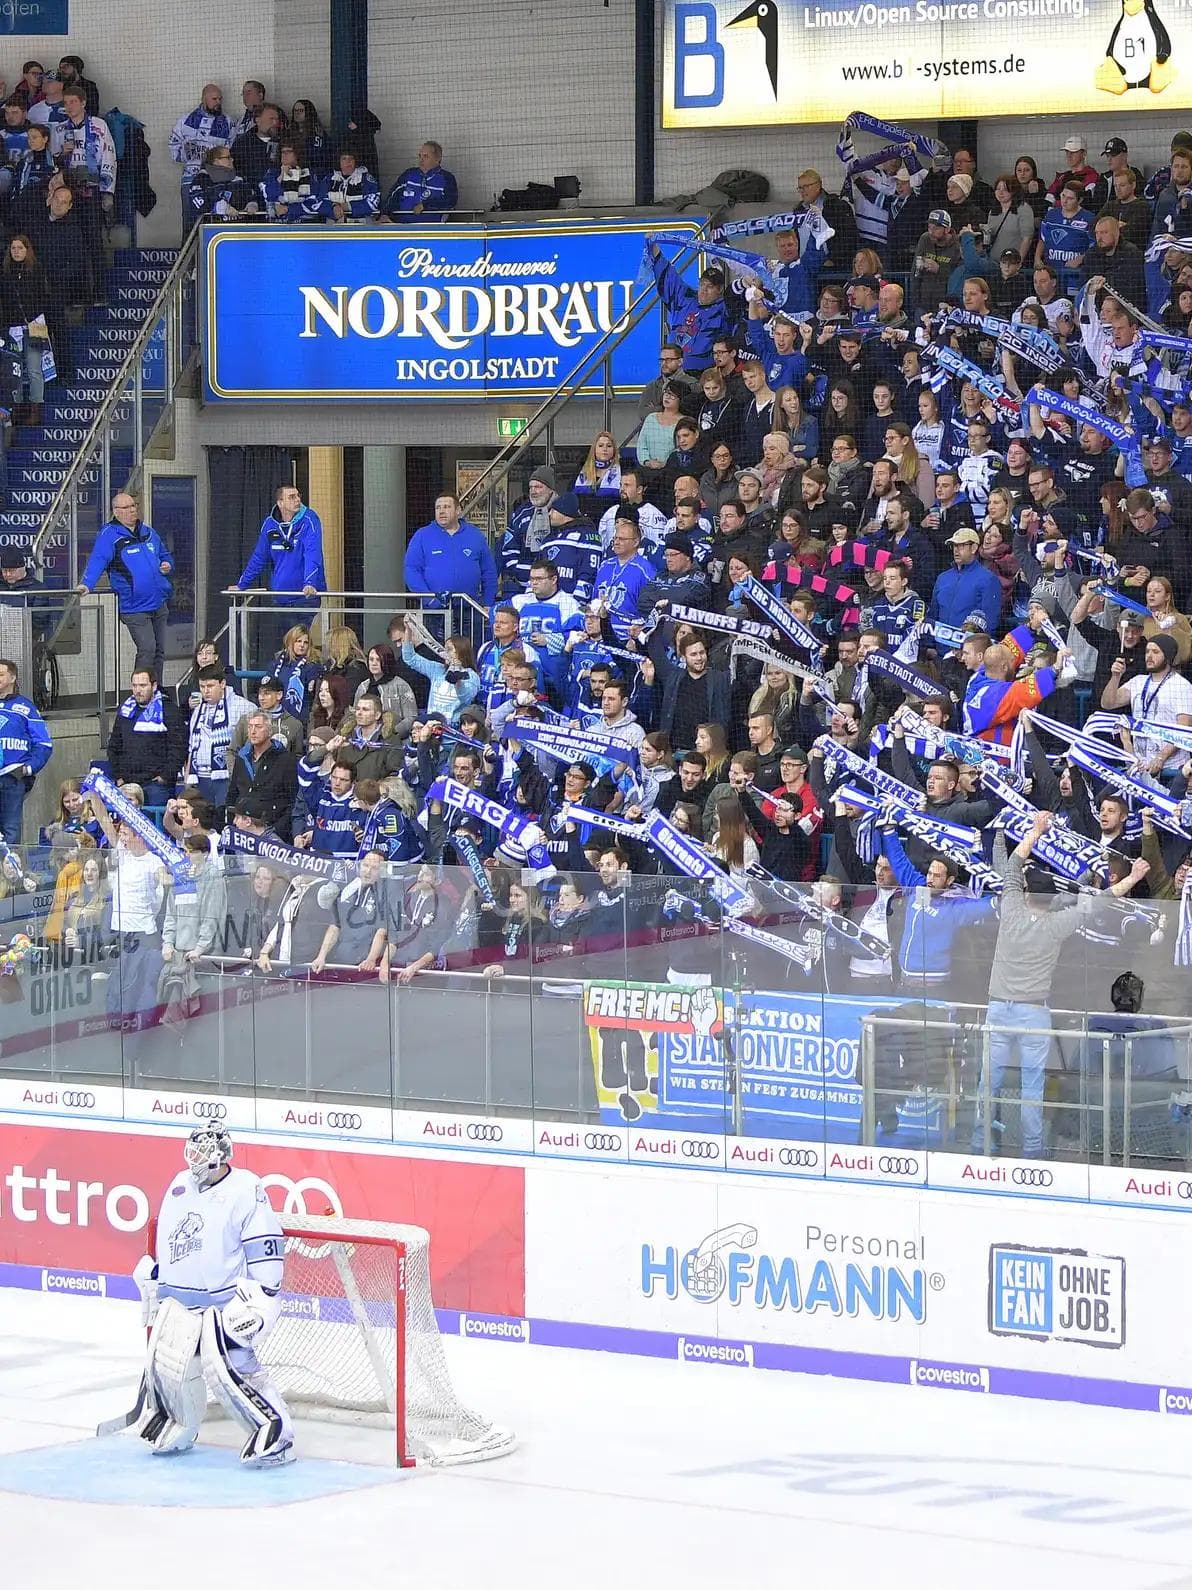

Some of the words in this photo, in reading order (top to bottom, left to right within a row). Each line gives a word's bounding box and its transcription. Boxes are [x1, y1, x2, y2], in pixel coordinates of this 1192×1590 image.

[803, 3, 911, 29] Linux/Open
[398, 247, 559, 280] Privatbrauerei
[299, 281, 633, 350] NORDBRÄU
[396, 356, 559, 381] INGOLSTADT
[671, 603, 738, 630] PLAYOFFS
[751, 584, 769, 605] ERC
[768, 599, 819, 651] INGOLSTADT
[858, 760, 922, 810] JAHRE
[233, 832, 255, 851] ERC
[258, 841, 332, 874] INGOLSTADT
[587, 986, 645, 1018] FREE
[645, 989, 691, 1024] MC!
[23, 1088, 58, 1105] Audi
[670, 1076, 697, 1089] WIR
[700, 1078, 751, 1094] STEN
[754, 1083, 787, 1097] FEST
[152, 1098, 189, 1117] Audi
[285, 1107, 323, 1127] Audi
[423, 1119, 463, 1139] Audi
[539, 1129, 580, 1148] Audi
[635, 1137, 677, 1156] Audi
[731, 1144, 775, 1164] Audi
[830, 1152, 874, 1172] Audi
[962, 1163, 1007, 1184] Audi
[1125, 1176, 1172, 1197] Audi
[263, 1239, 278, 1257] 31
[806, 1225, 926, 1261] Personal
[1001, 1254, 1045, 1287] KEIN
[1058, 1264, 1111, 1296] OHNE
[47, 1275, 101, 1294] covestro
[641, 1243, 927, 1325] HOFMANN
[280, 1299, 314, 1315] estro
[1001, 1294, 1045, 1328] FAN
[1059, 1296, 1117, 1334] JOB.
[465, 1319, 523, 1339] covestro
[683, 1342, 746, 1364] covestro
[916, 1365, 982, 1388] covestro
[239, 1383, 281, 1421] CCM
